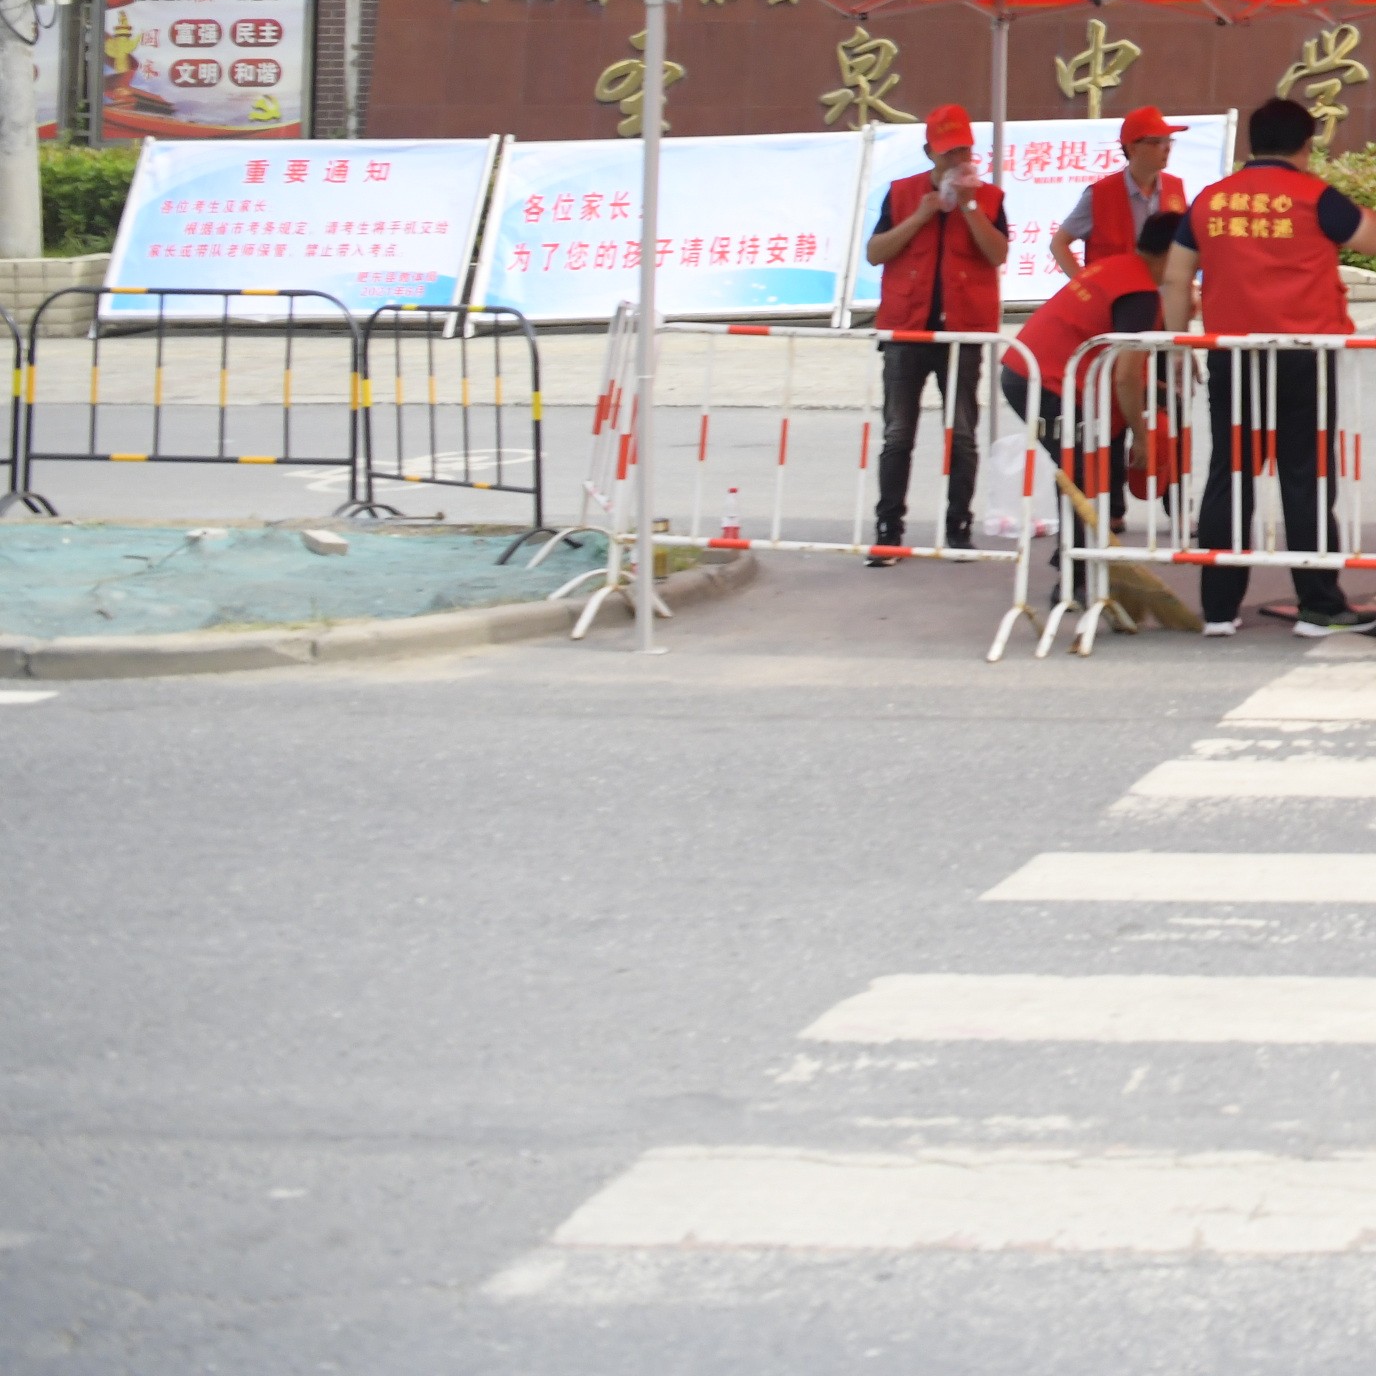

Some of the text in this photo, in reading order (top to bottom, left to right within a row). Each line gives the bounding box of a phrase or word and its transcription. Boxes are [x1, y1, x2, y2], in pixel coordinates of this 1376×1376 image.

[174, 23, 280, 44] 富强 民主
[173, 62, 279, 84] 文明 和谐
[987, 139, 1128, 175] 温馨提示
[243, 159, 391, 184] 重要通知
